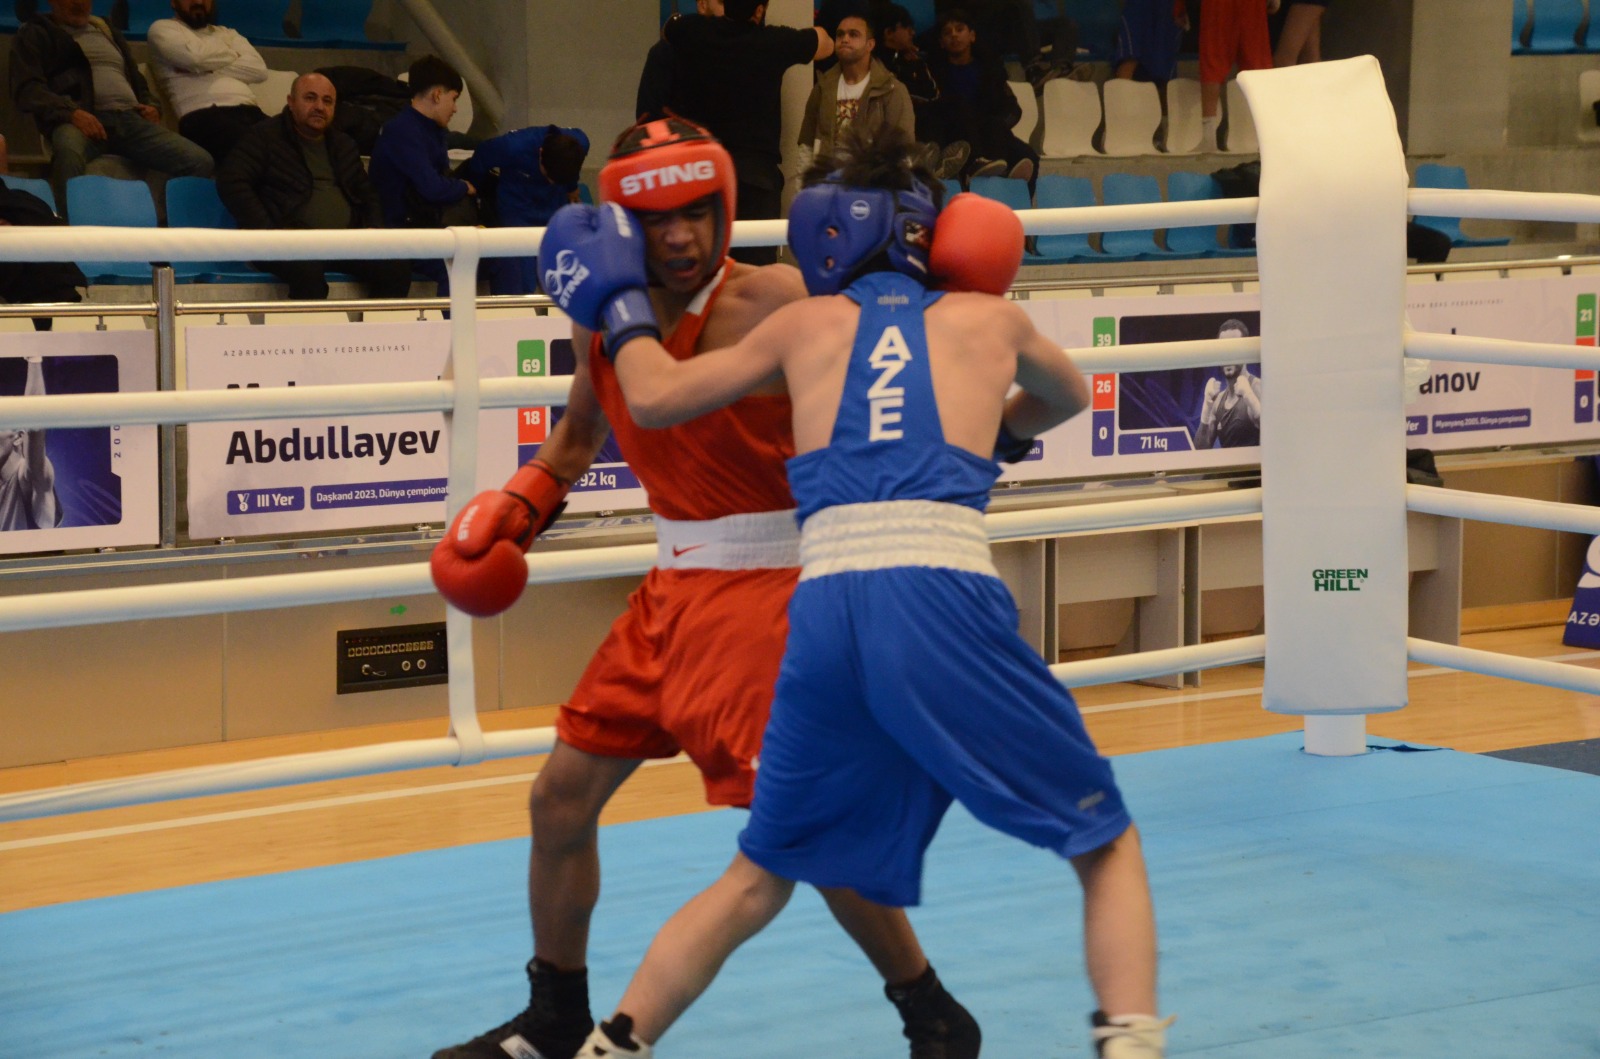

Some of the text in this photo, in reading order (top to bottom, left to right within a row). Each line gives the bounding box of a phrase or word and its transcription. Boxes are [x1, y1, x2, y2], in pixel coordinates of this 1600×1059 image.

[619, 160, 715, 196] STING
[1580, 308, 1592, 321] 21
[1096, 333, 1112, 347] 39
[223, 348, 294, 357] AZƏRBAYCAN
[301, 347, 328, 355] BOKS
[522, 358, 540, 373] 69
[867, 325, 912, 442] AZE
[1096, 380, 1111, 394] 26
[1419, 371, 1480, 395] anov
[1580, 395, 1588, 408] 0
[523, 410, 540, 425] 18
[1099, 426, 1108, 440] 0
[113, 424, 121, 458] 200
[225, 425, 441, 466] Abdullayev
[1140, 435, 1168, 451] 71 kq
[600, 471, 616, 488] kq
[354, 489, 378, 499] 2023,
[379, 488, 405, 499] Dünya
[406, 485, 448, 498] çempionat
[257, 494, 270, 507] III
[271, 493, 295, 506] Yer
[1312, 568, 1368, 579] GREEN
[1314, 579, 1361, 591] HILL
[1567, 610, 1600, 626] AZƏ
